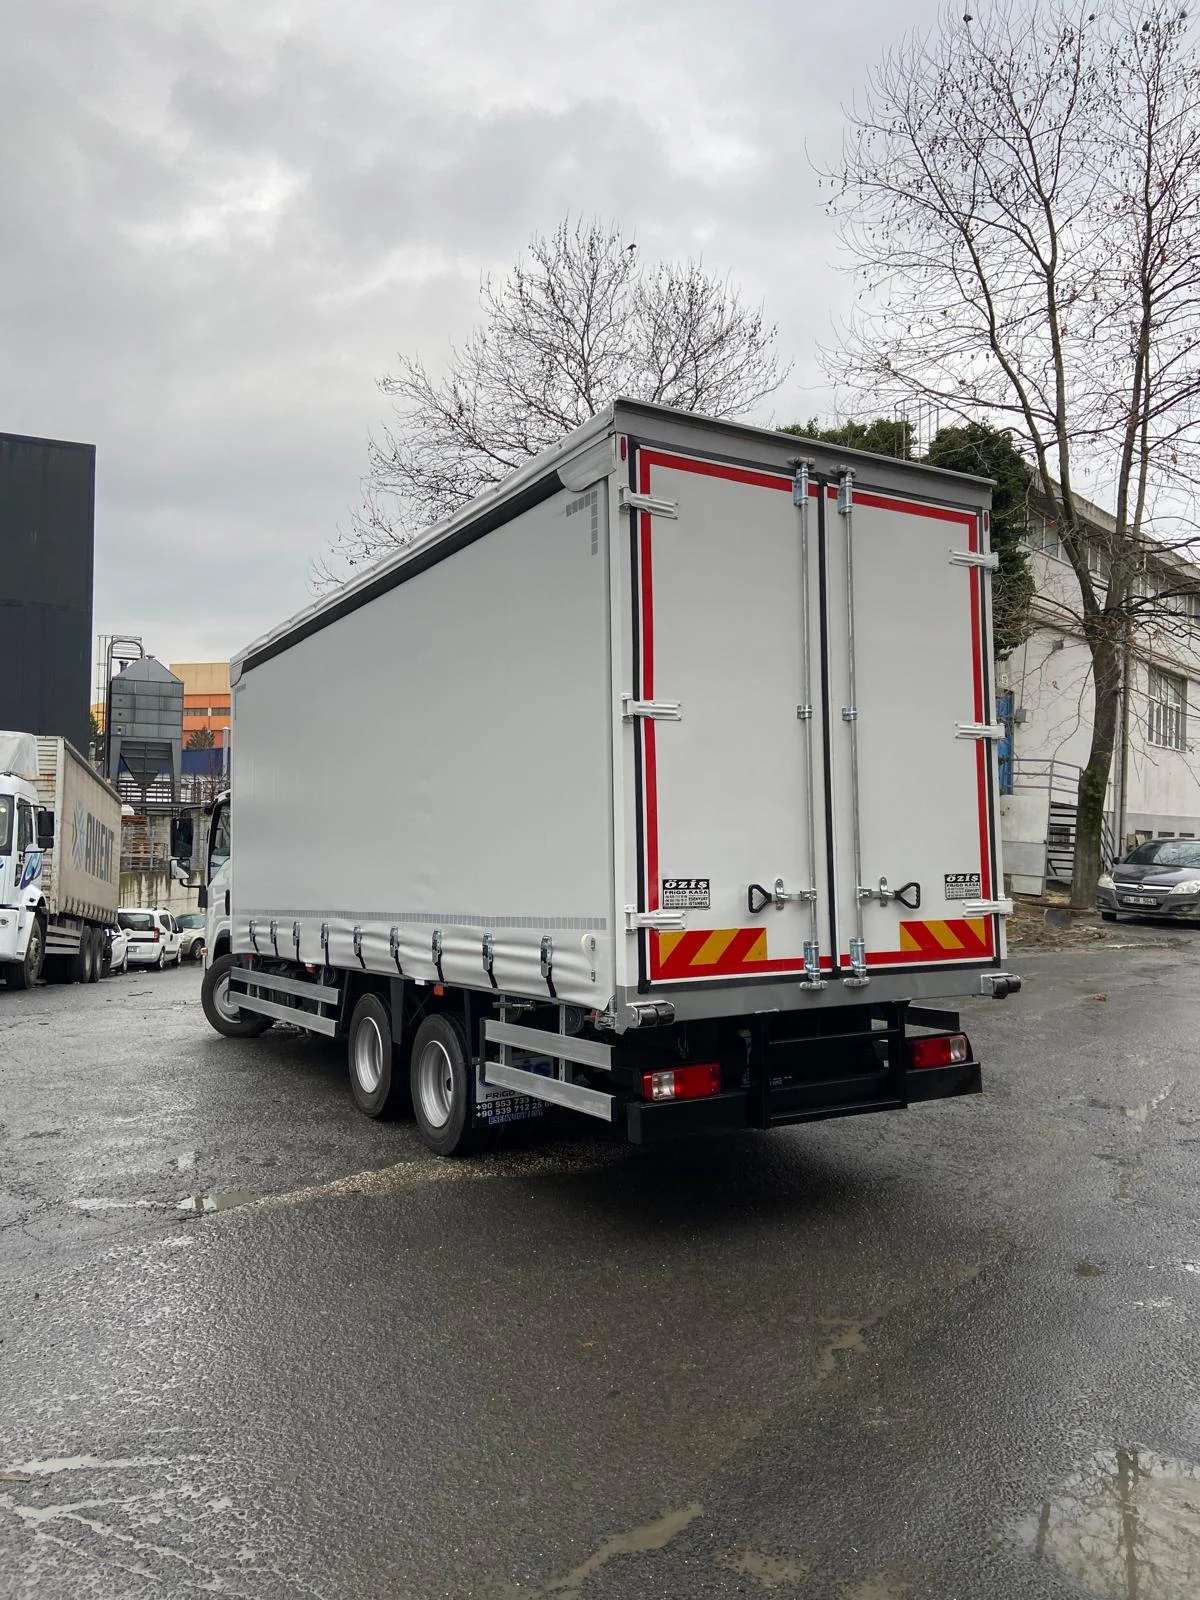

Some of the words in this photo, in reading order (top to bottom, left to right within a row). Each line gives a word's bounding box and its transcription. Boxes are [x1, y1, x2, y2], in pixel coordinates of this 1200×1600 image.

[495, 1100, 511, 1108] 553
[475, 1110, 493, 1118] +90
[495, 1107, 511, 1115] 539
[514, 1104, 530, 1112] 712
